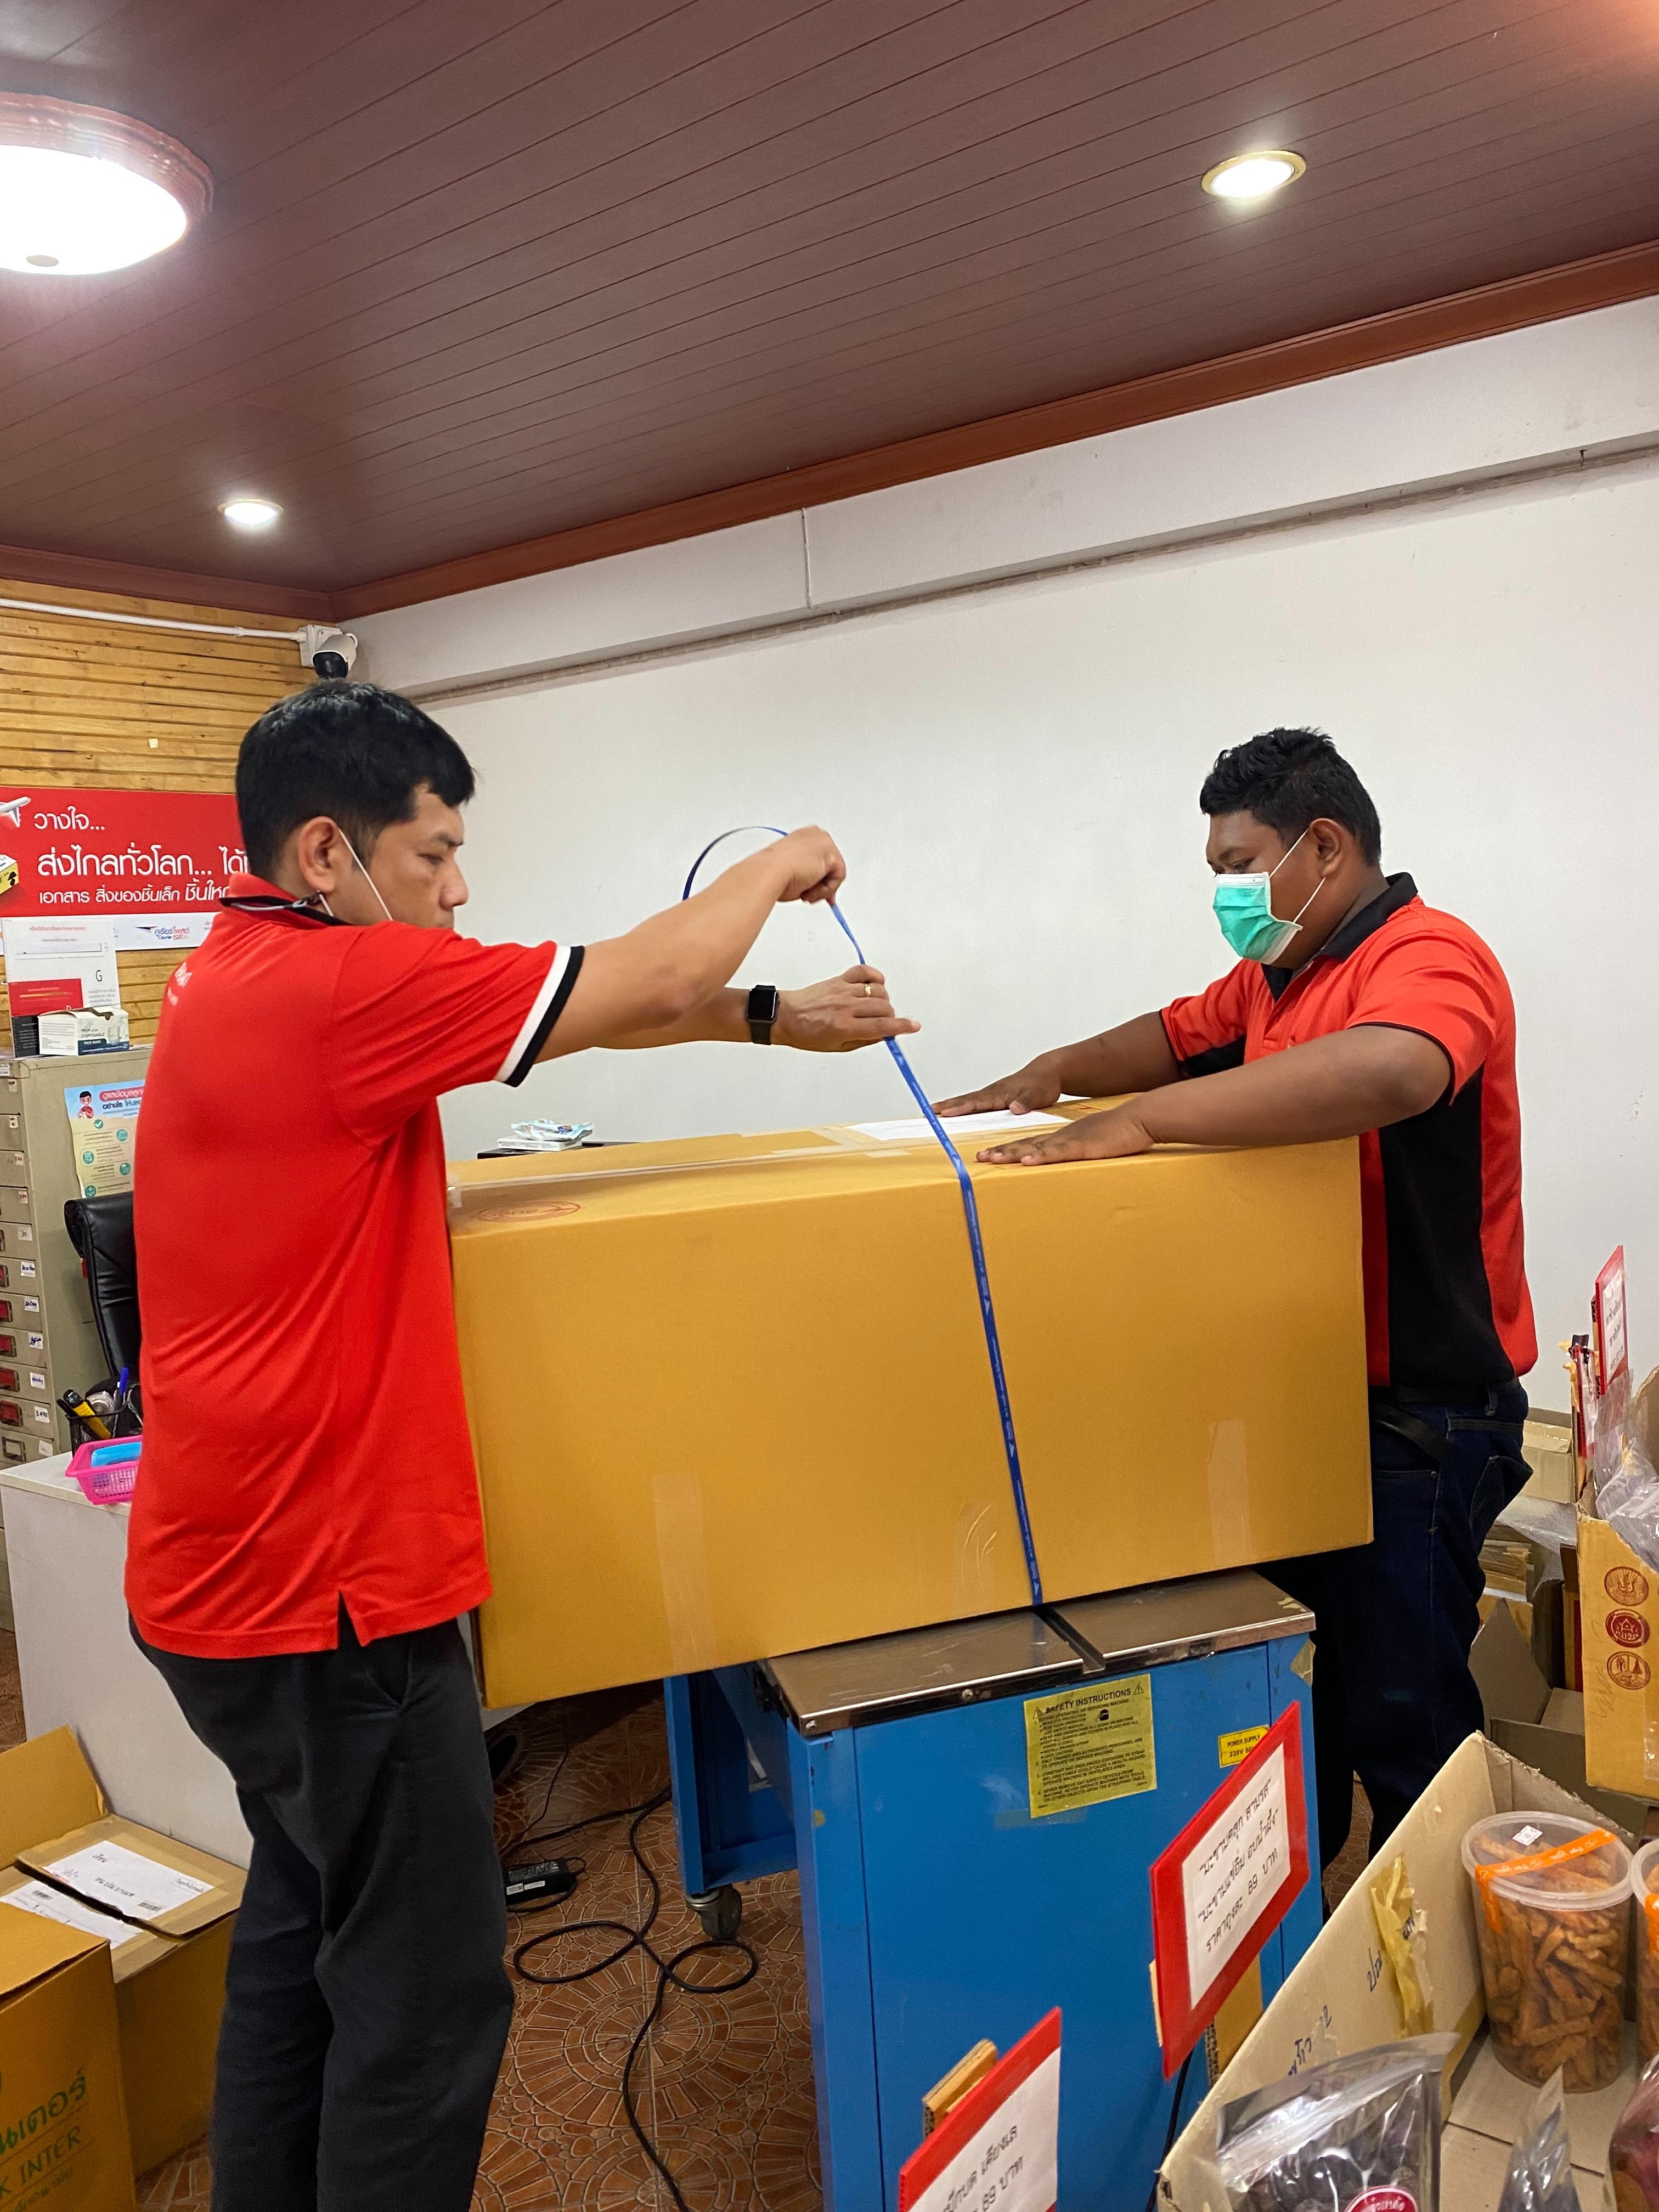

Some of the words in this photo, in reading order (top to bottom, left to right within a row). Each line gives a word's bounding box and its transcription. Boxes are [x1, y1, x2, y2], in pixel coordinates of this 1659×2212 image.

[34, 805, 105, 831] วางใจ...
[37, 842, 212, 876] ส่งไกลทั่วโลก...
[40, 889, 90, 904] เอกสาร
[95, 884, 180, 902] สิ่งของชิ้นเล็ก
[185, 878, 230, 901] ชิ้นให
[95, 970, 103, 982] G
[1045, 1701, 1074, 1713] SAFETY
[1076, 1688, 1131, 1707] INSTRUCTIONS
[1244, 1735, 1260, 1743] SUPPLY
[1229, 1749, 1243, 1757] 220V
[1249, 1874, 1257, 1895] 89
[1263, 1848, 1278, 1875] บาท
[20, 2125, 80, 2185] INTER
[1000, 2156, 1023, 2190] บาท
